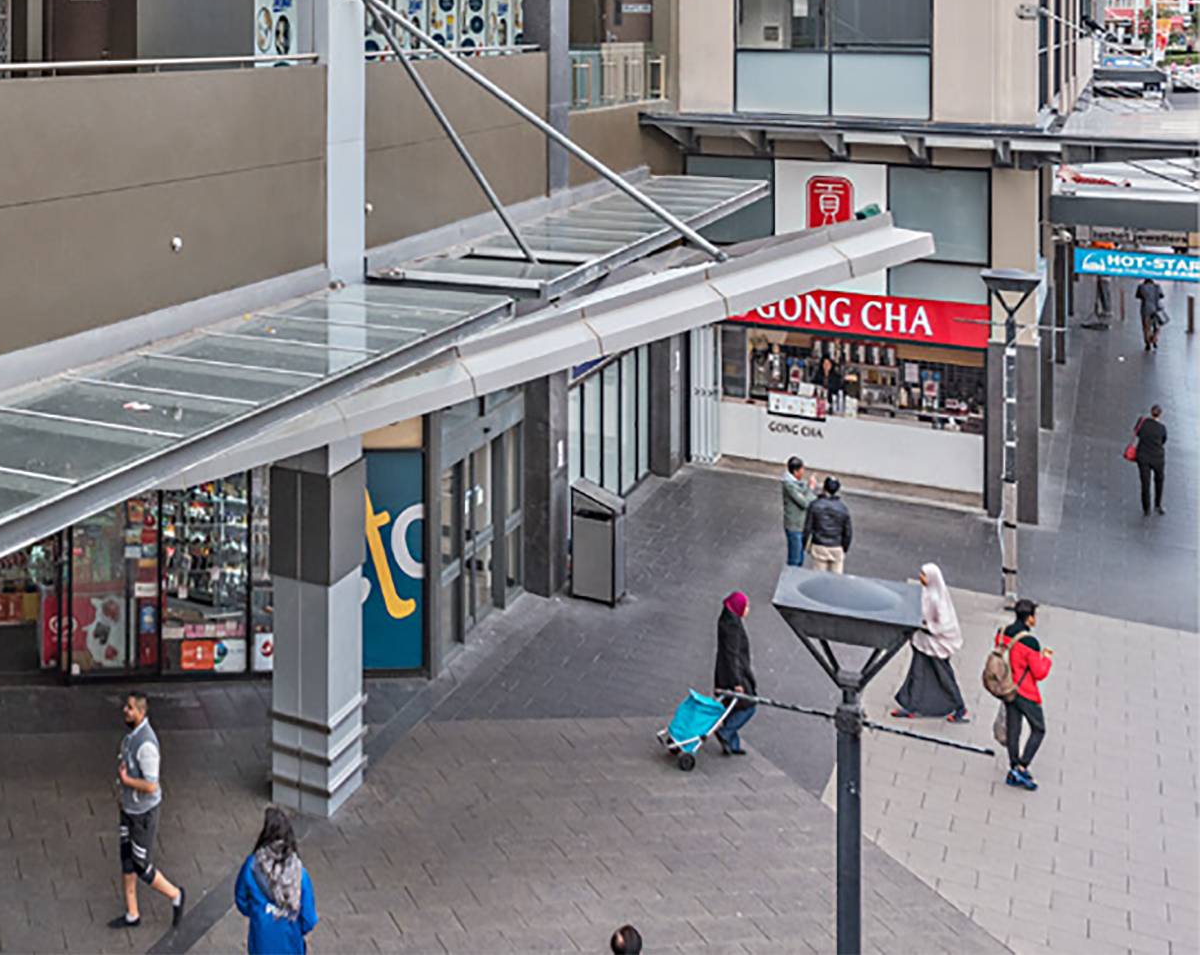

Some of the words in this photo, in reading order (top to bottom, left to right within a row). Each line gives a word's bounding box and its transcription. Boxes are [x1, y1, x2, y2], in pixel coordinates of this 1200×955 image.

[755, 294, 850, 328] GONG
[861, 300, 933, 336] CHA
[767, 420, 799, 437] GONG
[801, 424, 824, 439] CHA
